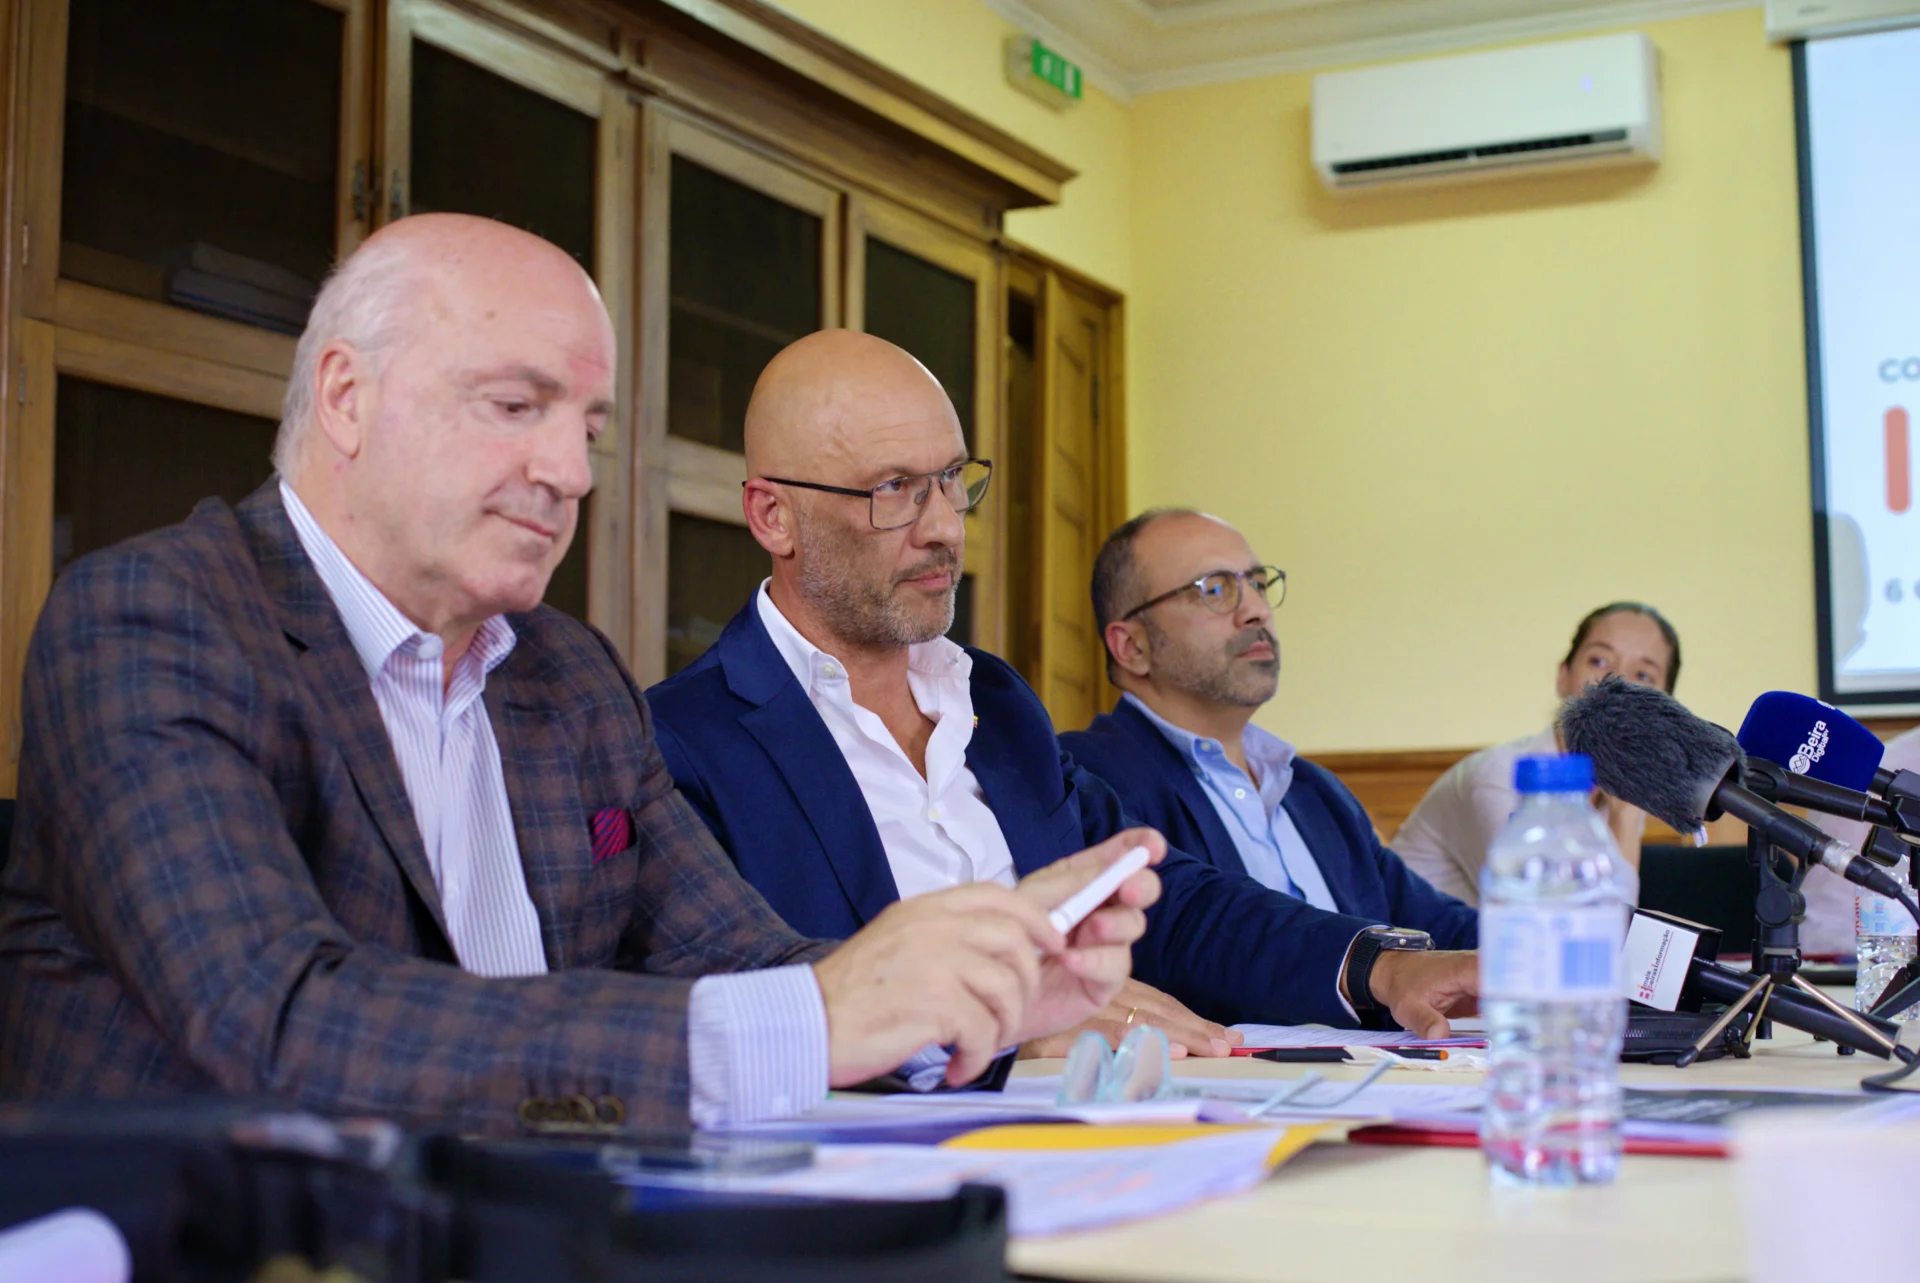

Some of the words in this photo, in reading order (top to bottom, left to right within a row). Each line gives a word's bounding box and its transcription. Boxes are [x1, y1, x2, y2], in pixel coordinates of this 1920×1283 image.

[1797, 720, 1827, 759] Beira
[1811, 735, 1829, 763] Digital
[1643, 970, 1651, 987] mais
